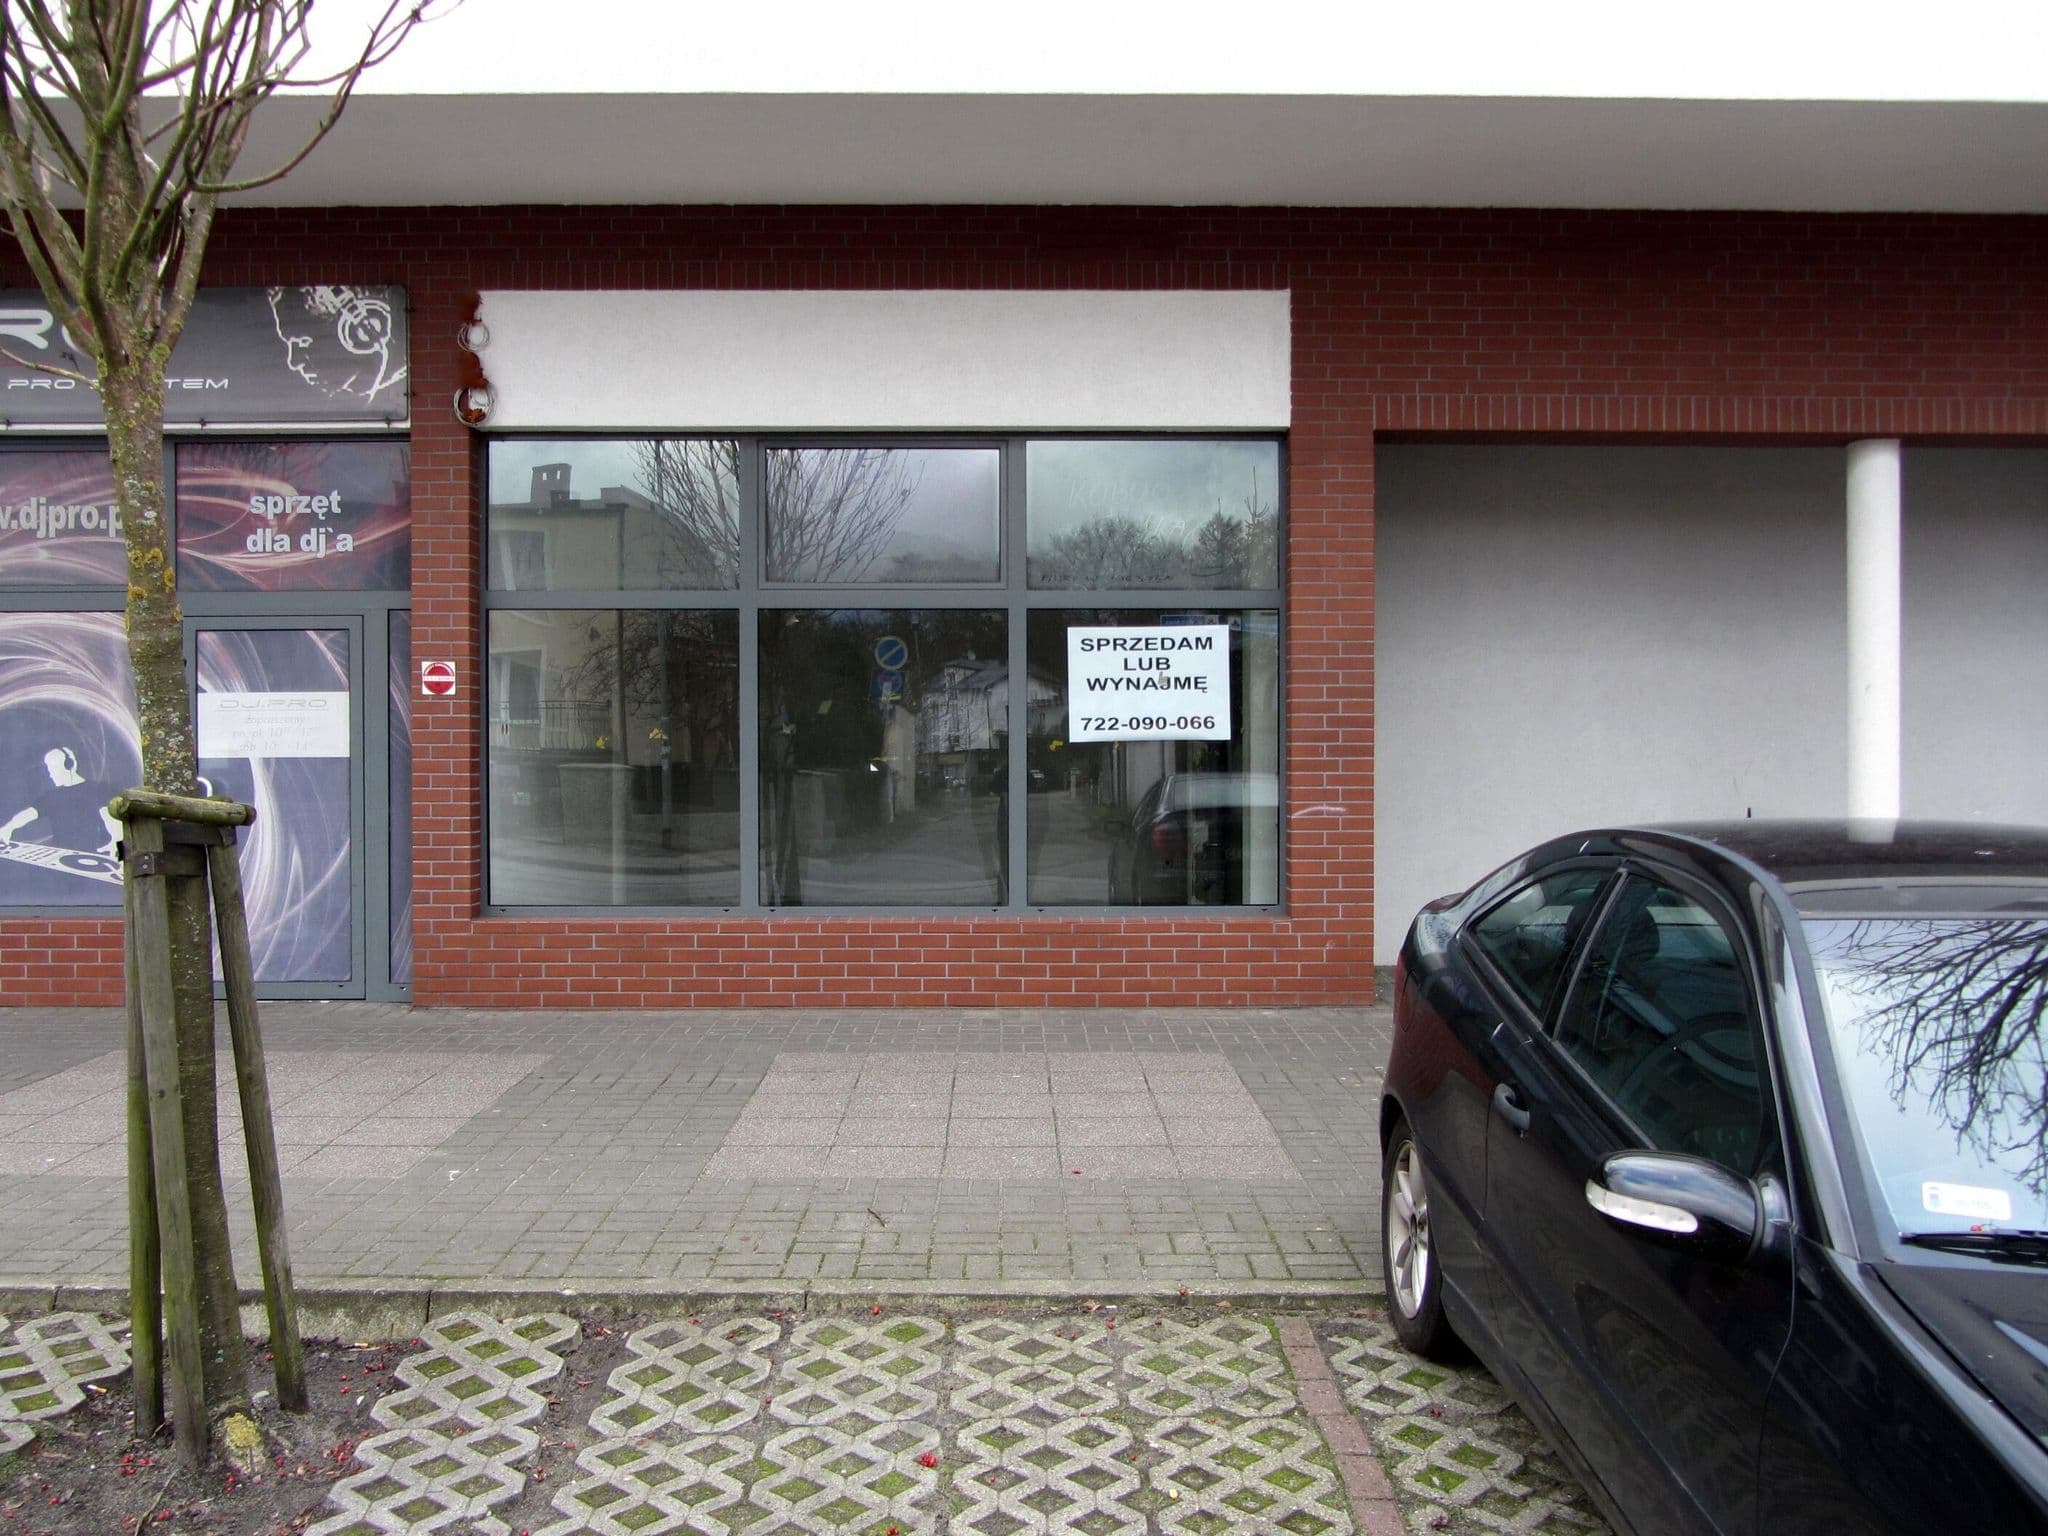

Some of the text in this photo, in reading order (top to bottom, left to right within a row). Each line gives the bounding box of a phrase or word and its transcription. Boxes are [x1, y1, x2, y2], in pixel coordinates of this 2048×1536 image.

[8, 379, 76, 390] PRO
[250, 489, 342, 520] sprzęt
[246, 527, 291, 553] dla
[1080, 636, 1213, 652] SPRZEDAM
[1123, 657, 1171, 671] LUB
[1086, 675, 1208, 694] WYNAJMĘ
[1080, 716, 1216, 731] 722-090-066
